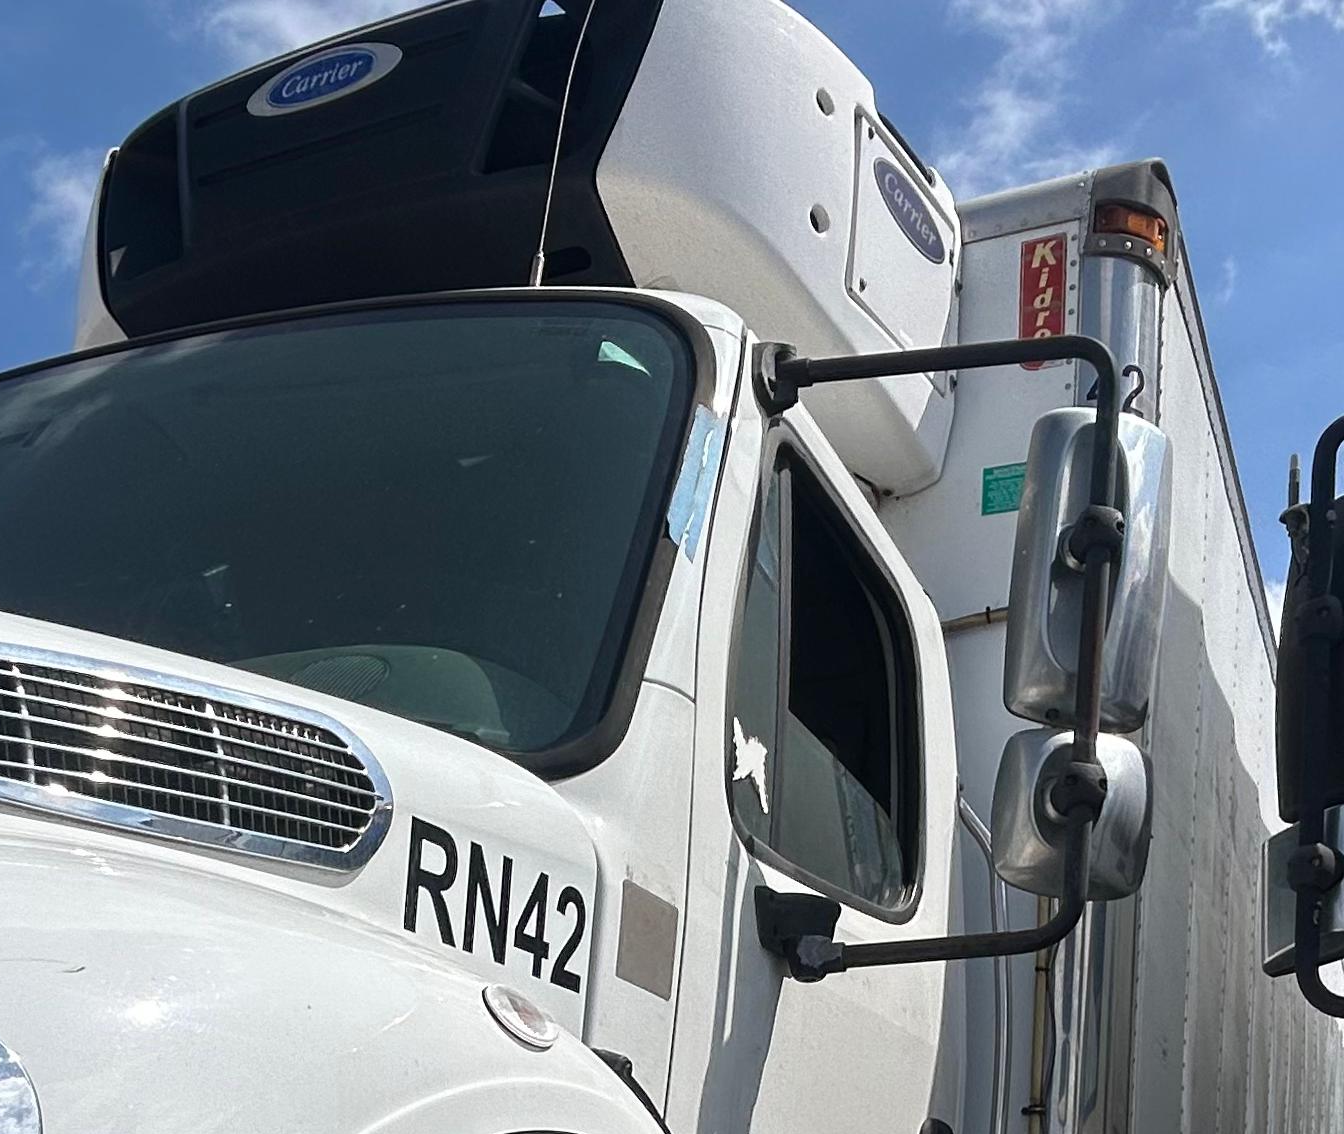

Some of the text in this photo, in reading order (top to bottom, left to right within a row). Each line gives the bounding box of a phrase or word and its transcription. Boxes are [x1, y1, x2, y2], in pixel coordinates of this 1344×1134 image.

[281, 59, 363, 98] Carrier
[883, 172, 937, 246] Carrier
[403, 815, 586, 994] RN42
